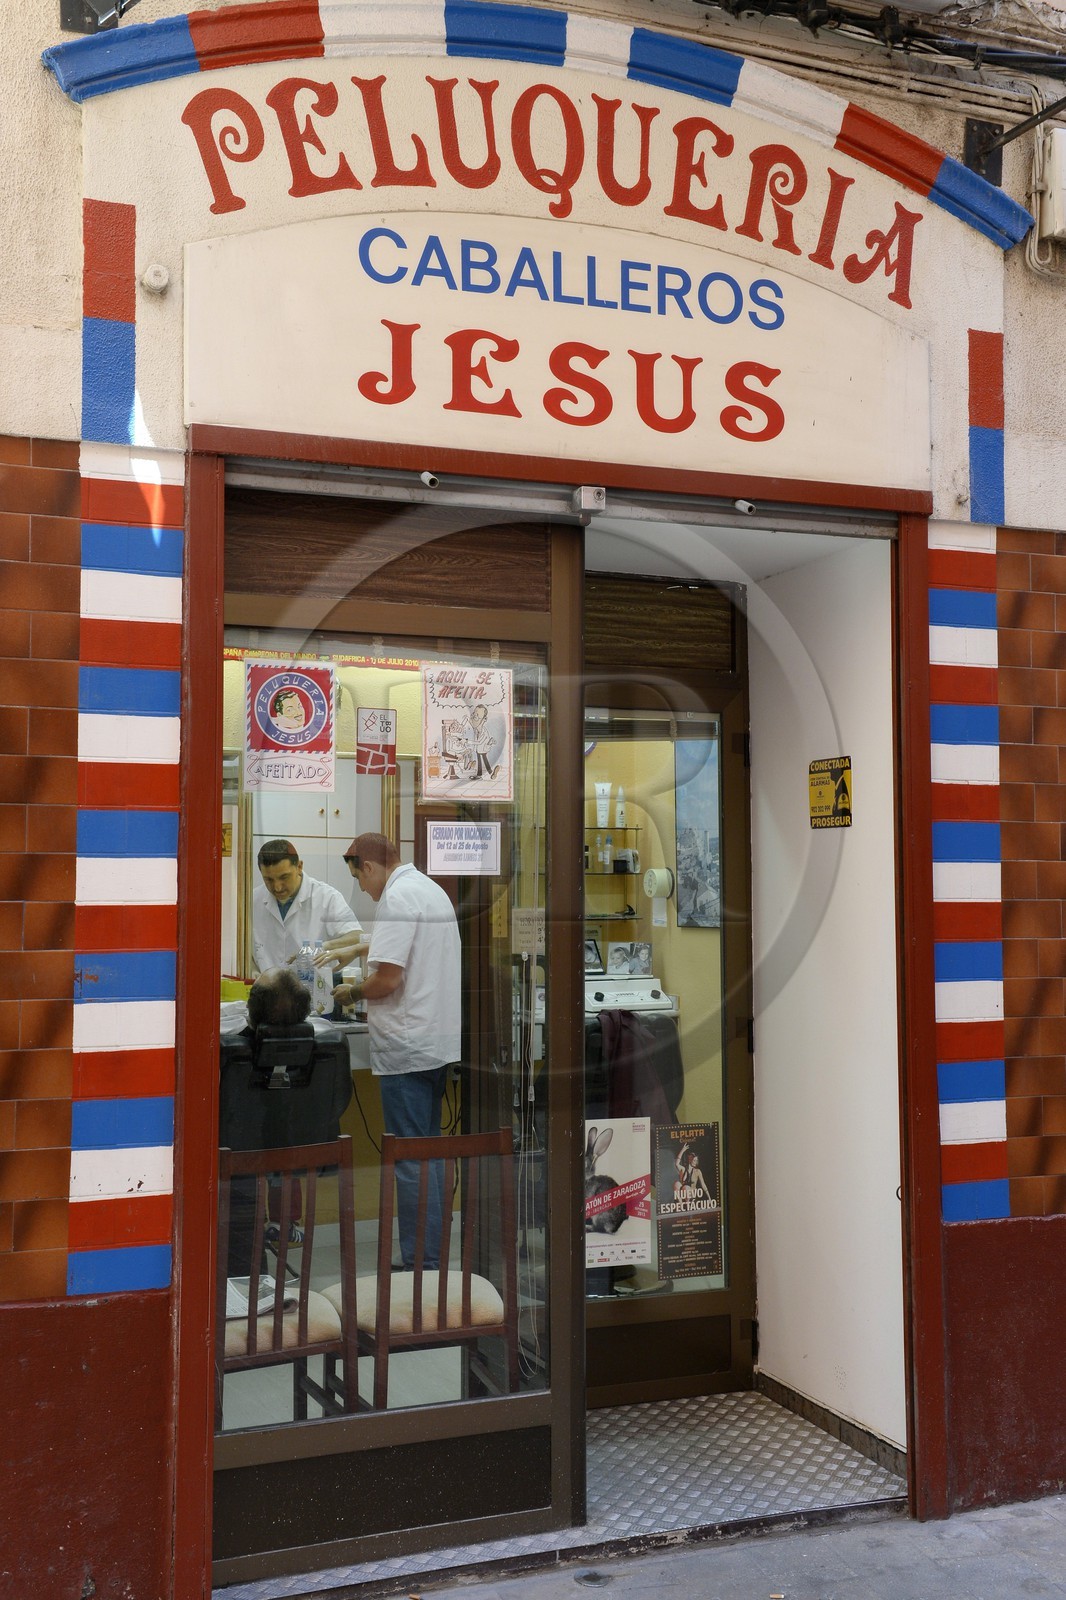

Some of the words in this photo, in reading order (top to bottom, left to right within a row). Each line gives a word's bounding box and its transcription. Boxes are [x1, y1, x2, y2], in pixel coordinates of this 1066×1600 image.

[181, 75, 923, 309] PELUQUERIA
[359, 228, 784, 329] CABALLEROS
[358, 320, 784, 442] JESUS
[405, 659, 419, 667] 2010
[436, 670, 468, 684] AQUI
[476, 671, 495, 685] SE
[257, 675, 325, 716] PELUQUERIA
[438, 685, 487, 700] AFEITA
[271, 730, 311, 743] JESUS
[255, 762, 327, 779] AFEITADO
[810, 758, 850, 771] CONECTADA
[811, 815, 851, 828] PROSEGUR
[432, 826, 454, 841] CERRADO
[454, 826, 464, 841] POR
[464, 827, 492, 841] VACACIONES
[436, 842, 446, 850] Del
[446, 842, 452, 850] 12
[453, 842, 458, 850] al
[458, 842, 464, 850] 25
[465, 842, 471, 850] de
[471, 842, 489, 852] Agosto
[670, 1130, 680, 1139] EL
[680, 1128, 705, 1138] PLATA
[603, 1193, 612, 1203] DE
[613, 1179, 646, 1199] ZARAGOZA
[674, 1188, 703, 1200] NUEVO
[660, 1199, 717, 1214] ESPECTÁCULO
